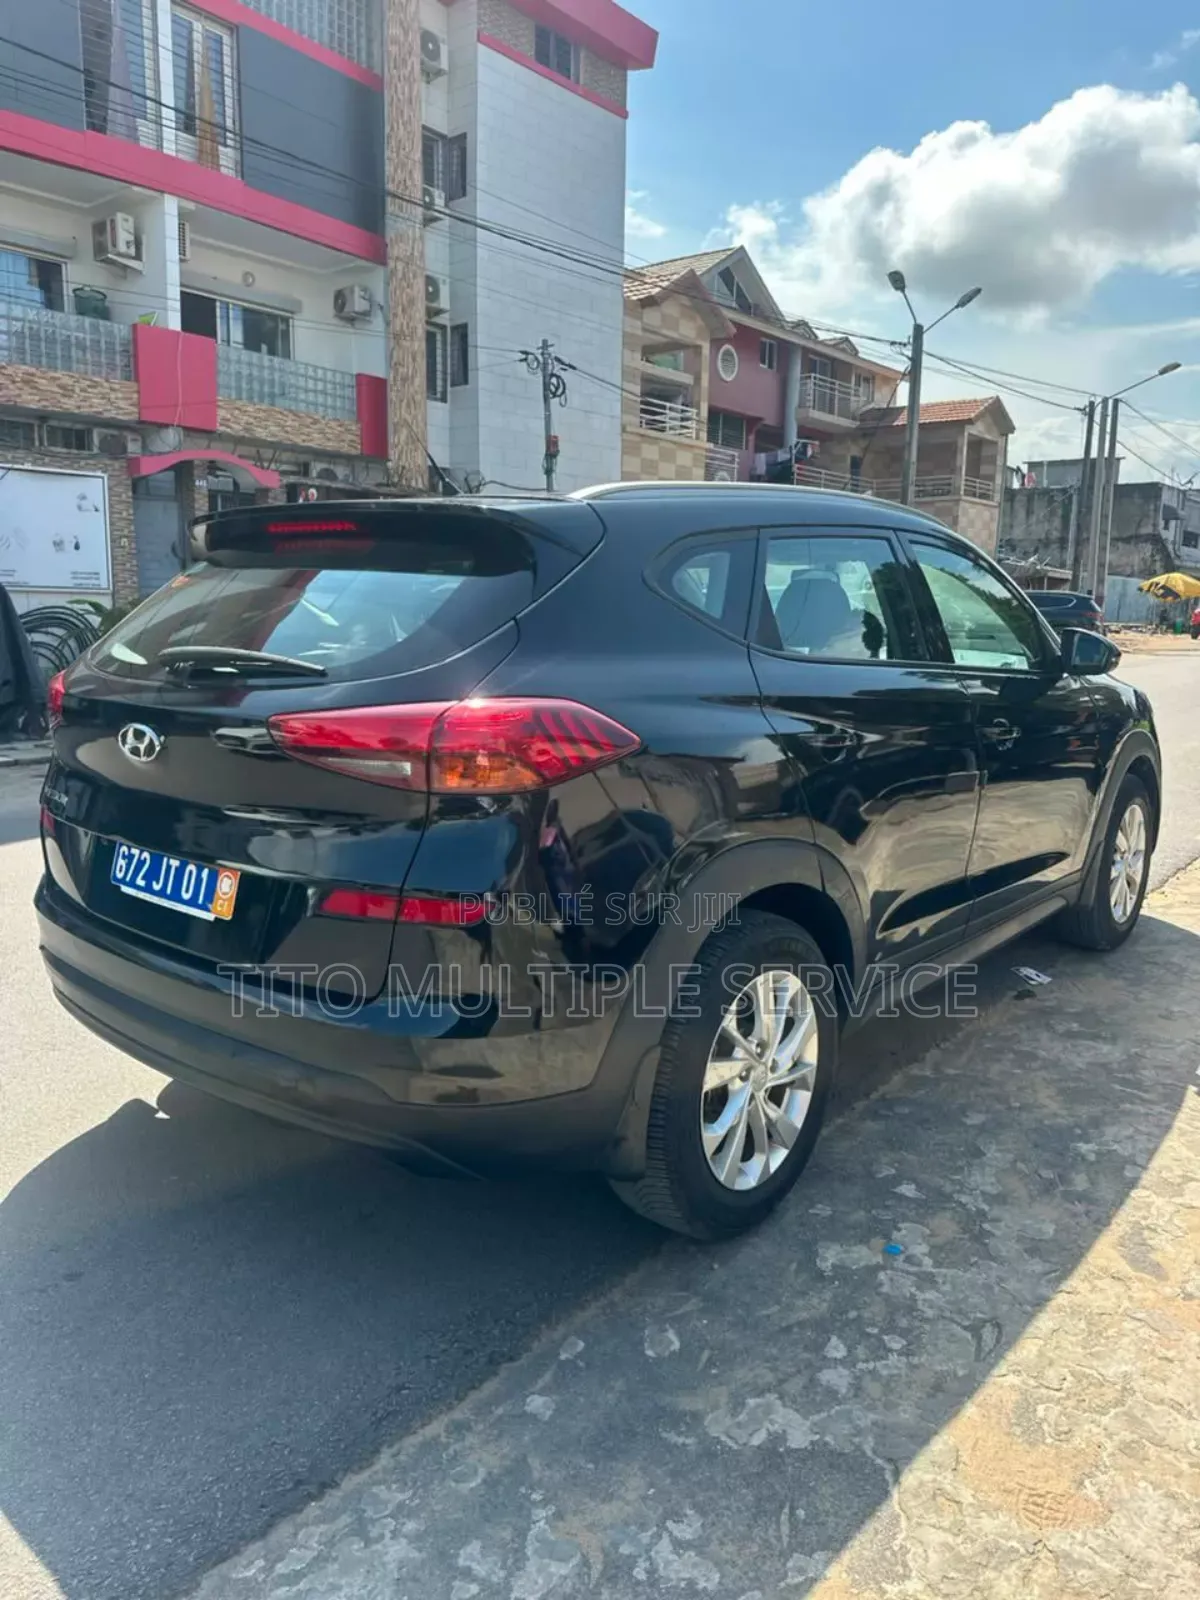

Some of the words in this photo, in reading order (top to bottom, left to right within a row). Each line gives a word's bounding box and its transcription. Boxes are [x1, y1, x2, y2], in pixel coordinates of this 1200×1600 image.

[115, 844, 151, 888] 672
[152, 856, 181, 896] JT
[181, 863, 210, 905] 01
